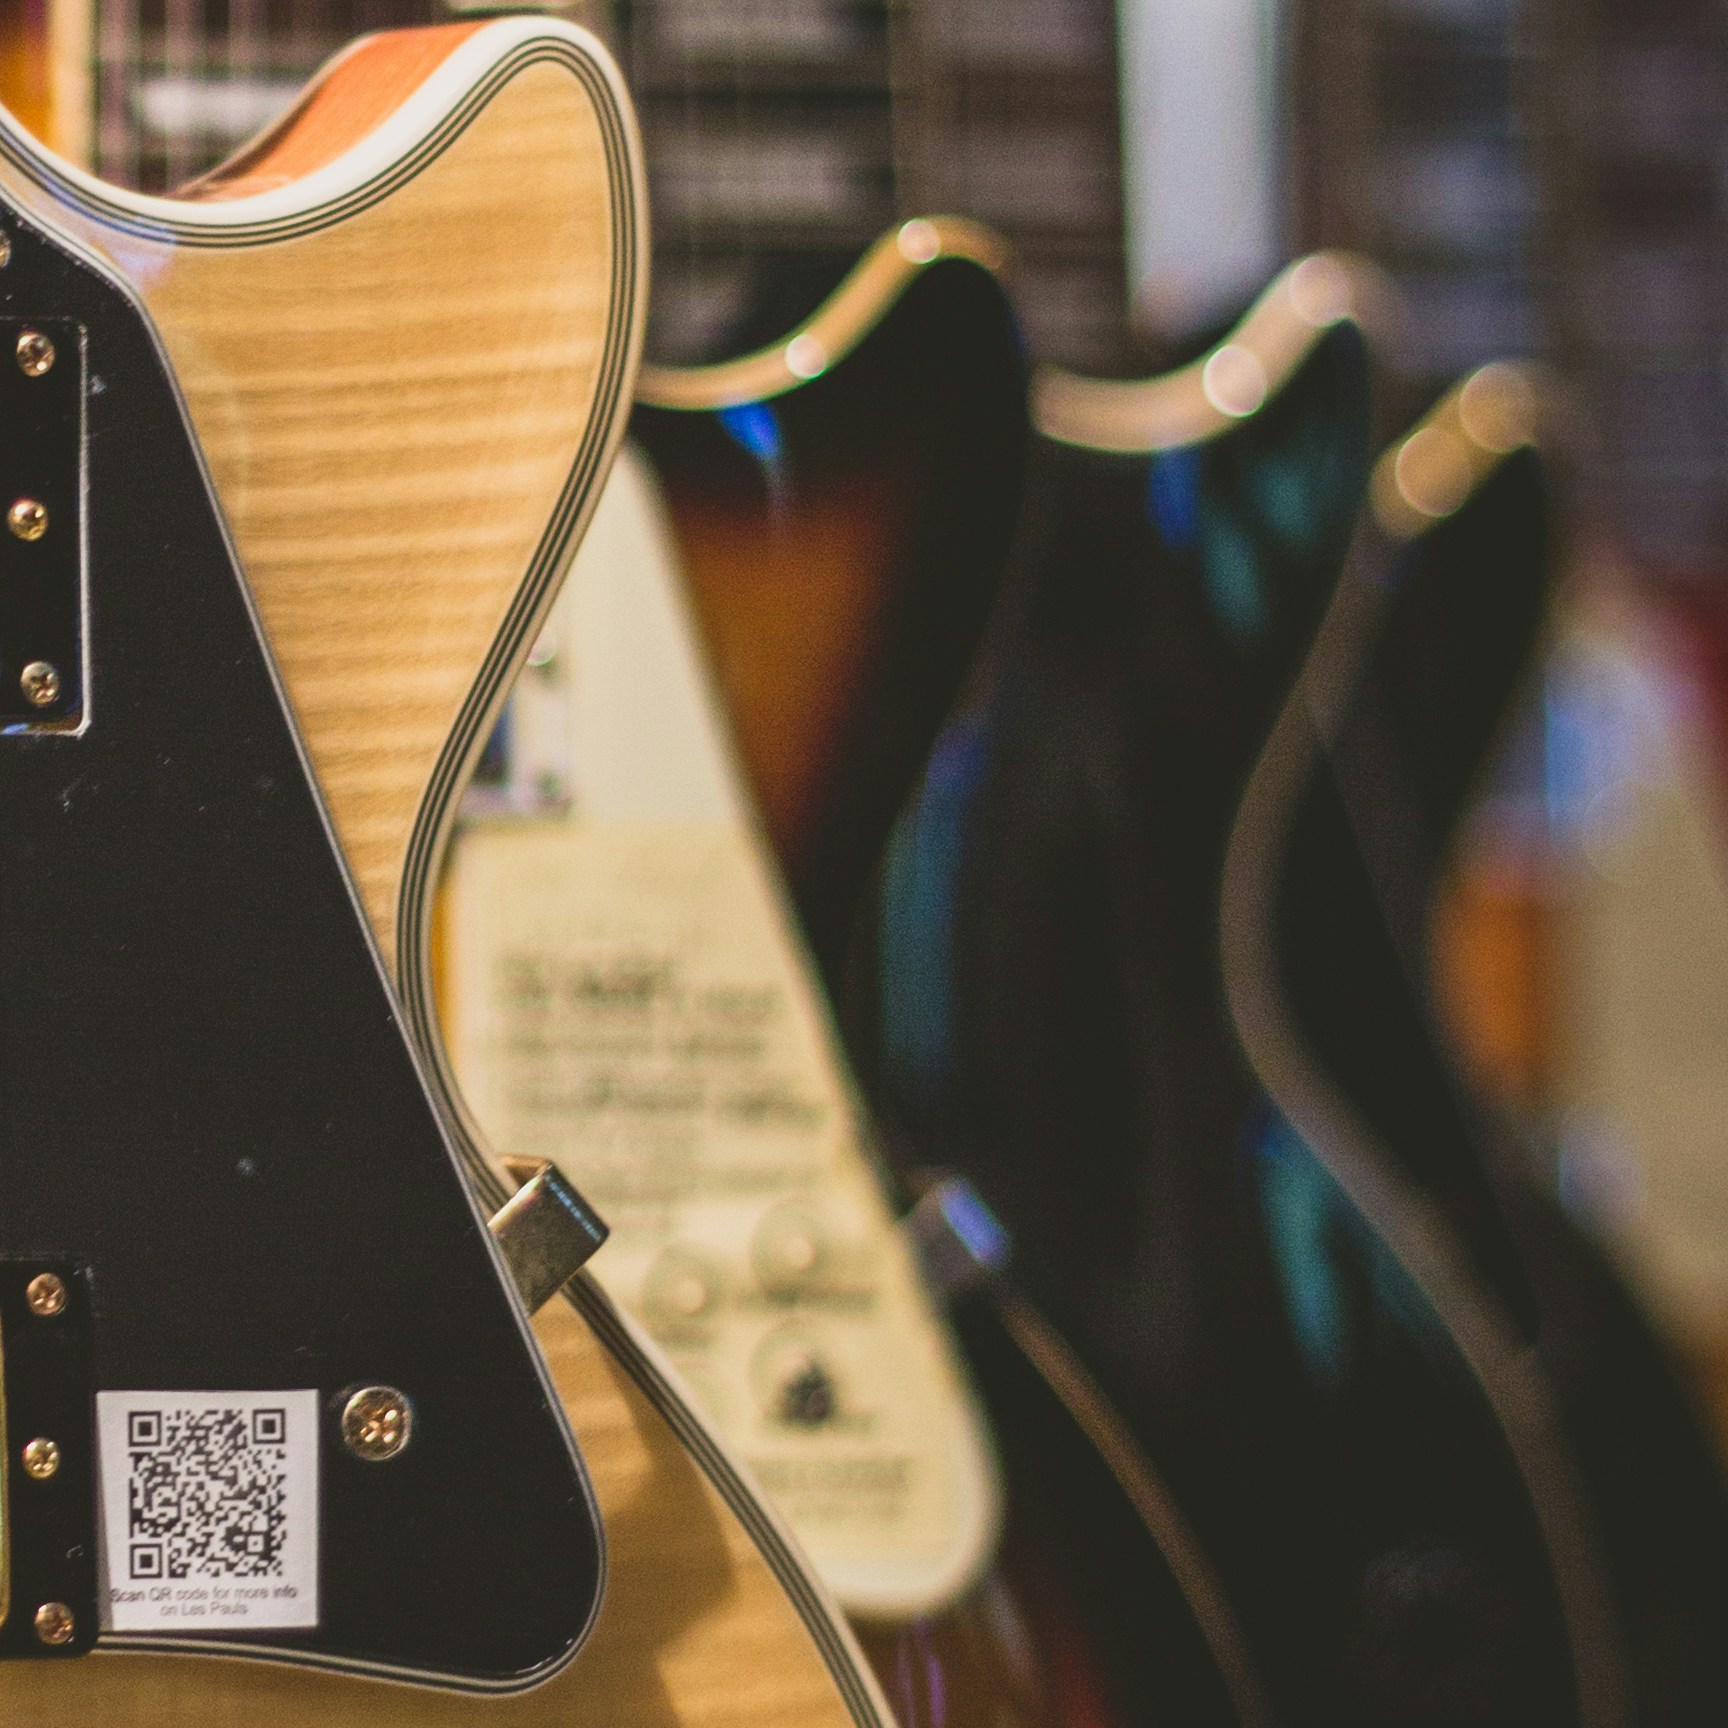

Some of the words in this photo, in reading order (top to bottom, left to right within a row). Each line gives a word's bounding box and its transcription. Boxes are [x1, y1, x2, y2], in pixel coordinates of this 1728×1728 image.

[111, 1588, 145, 1603] Scan
[148, 1587, 172, 1601] QR
[176, 1588, 208, 1601] code
[212, 1586, 230, 1600] for
[234, 1587, 270, 1600] more
[273, 1584, 298, 1599] info
[159, 1605, 177, 1616] on
[181, 1602, 207, 1616] Les
[210, 1601, 249, 1616] Pauls
